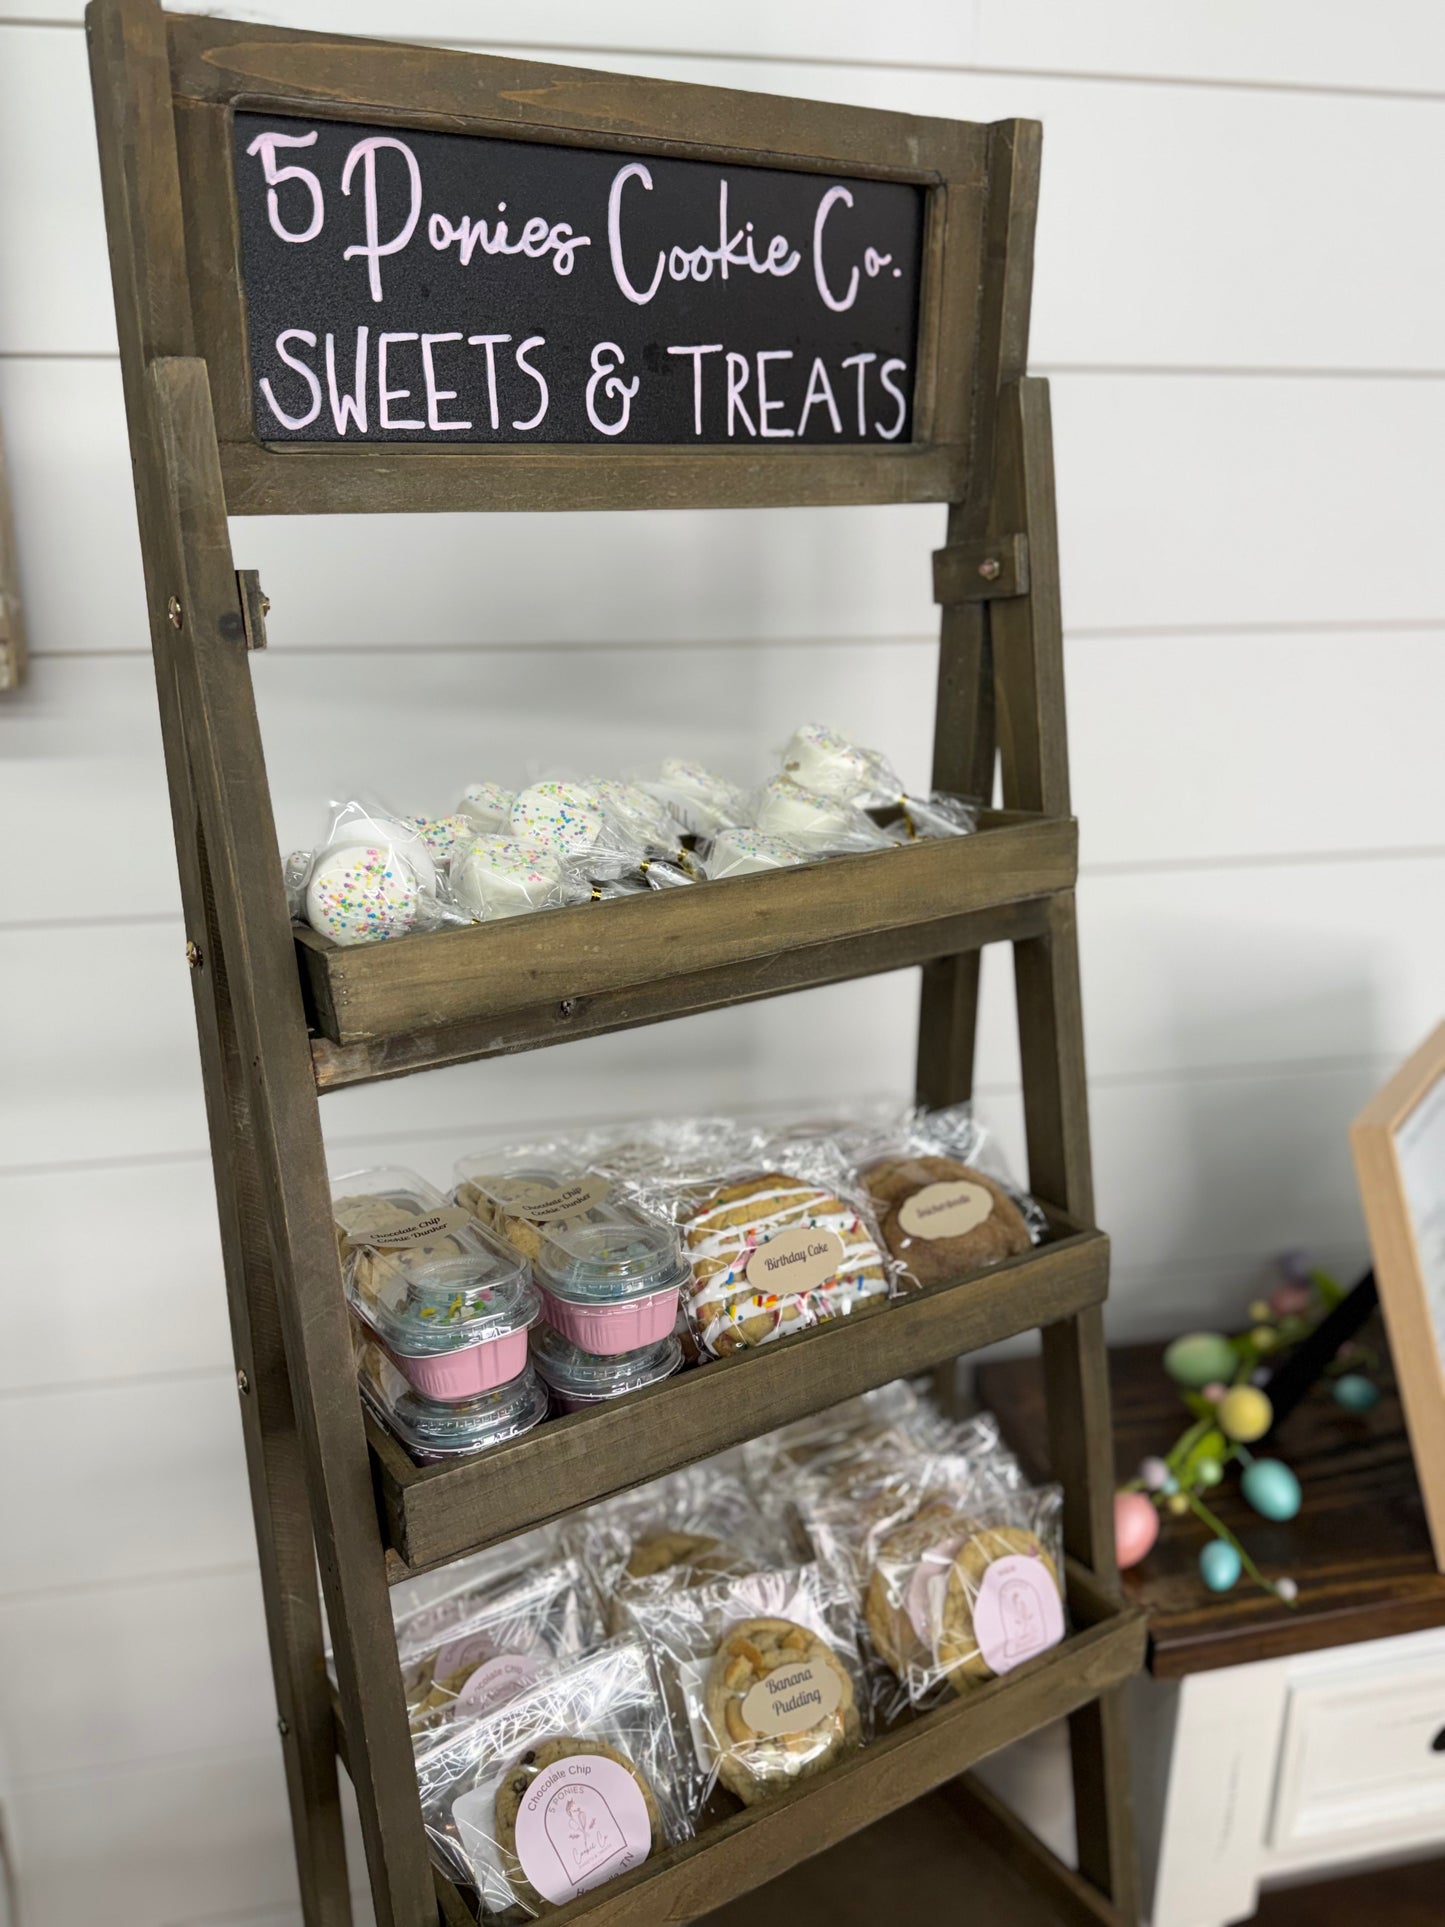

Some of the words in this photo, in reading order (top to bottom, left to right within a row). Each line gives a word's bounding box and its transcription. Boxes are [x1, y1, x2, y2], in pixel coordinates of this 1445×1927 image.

[246, 130, 325, 243] 5
[342, 136, 591, 302] Ponies
[608, 162, 799, 305] Cookie
[813, 184, 902, 311] Co.
[259, 326, 548, 435] SWEETS
[585, 341, 639, 435] &
[667, 344, 907, 440] TREATS
[562, 1187, 582, 1200] Chip
[411, 1223, 448, 1239] Dunker
[418, 1216, 441, 1229] Chip
[764, 1250, 807, 1272] Birthday
[807, 1242, 829, 1258] Cake
[765, 1668, 814, 1694] Banana
[772, 1689, 822, 1716] Pudding
[527, 1769, 567, 1812] Chocolate
[568, 1764, 592, 1776] Chip
[548, 1806, 556, 1814] 5
[553, 1786, 585, 1806] PONIES
[619, 1851, 635, 1868] TN
